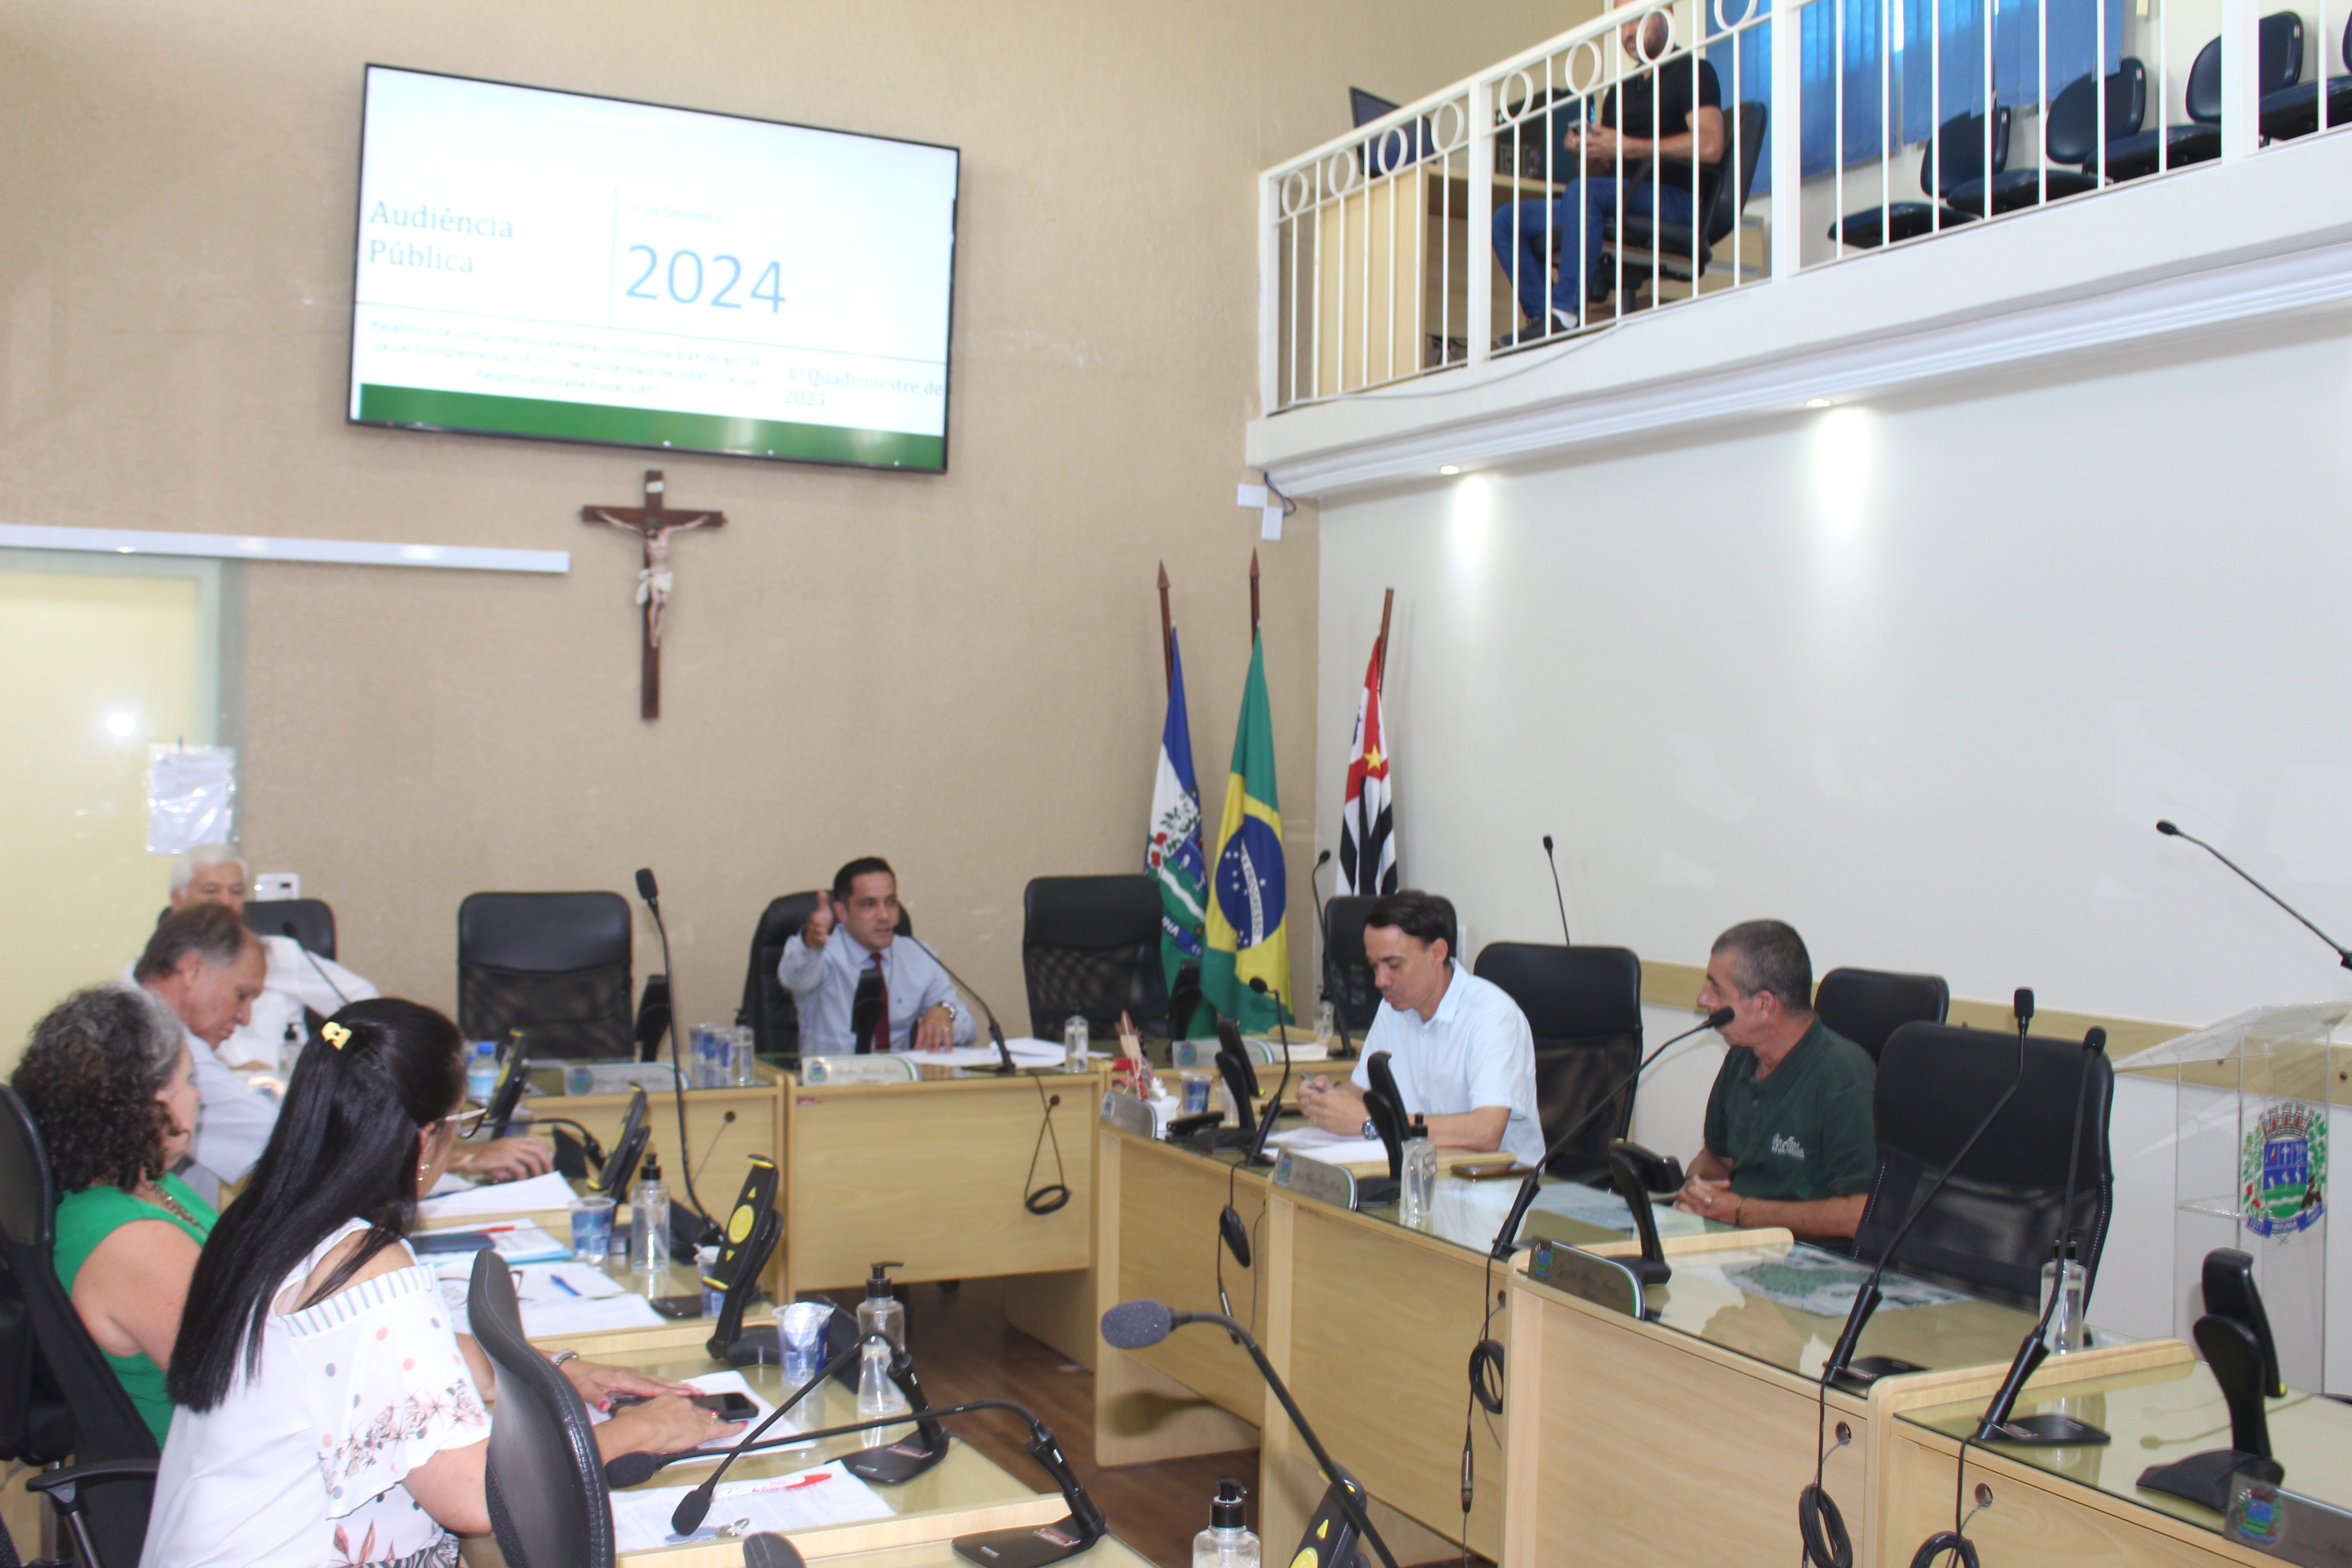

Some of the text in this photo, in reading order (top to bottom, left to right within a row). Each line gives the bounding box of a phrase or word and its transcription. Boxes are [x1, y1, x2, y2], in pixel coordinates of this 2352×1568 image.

[368, 199, 513, 237] Audiência
[368, 238, 473, 273] Pública
[624, 243, 788, 314] 2024
[784, 386, 826, 407] 2023
[808, 368, 920, 393] Quadrimestre
[924, 379, 944, 396] de
